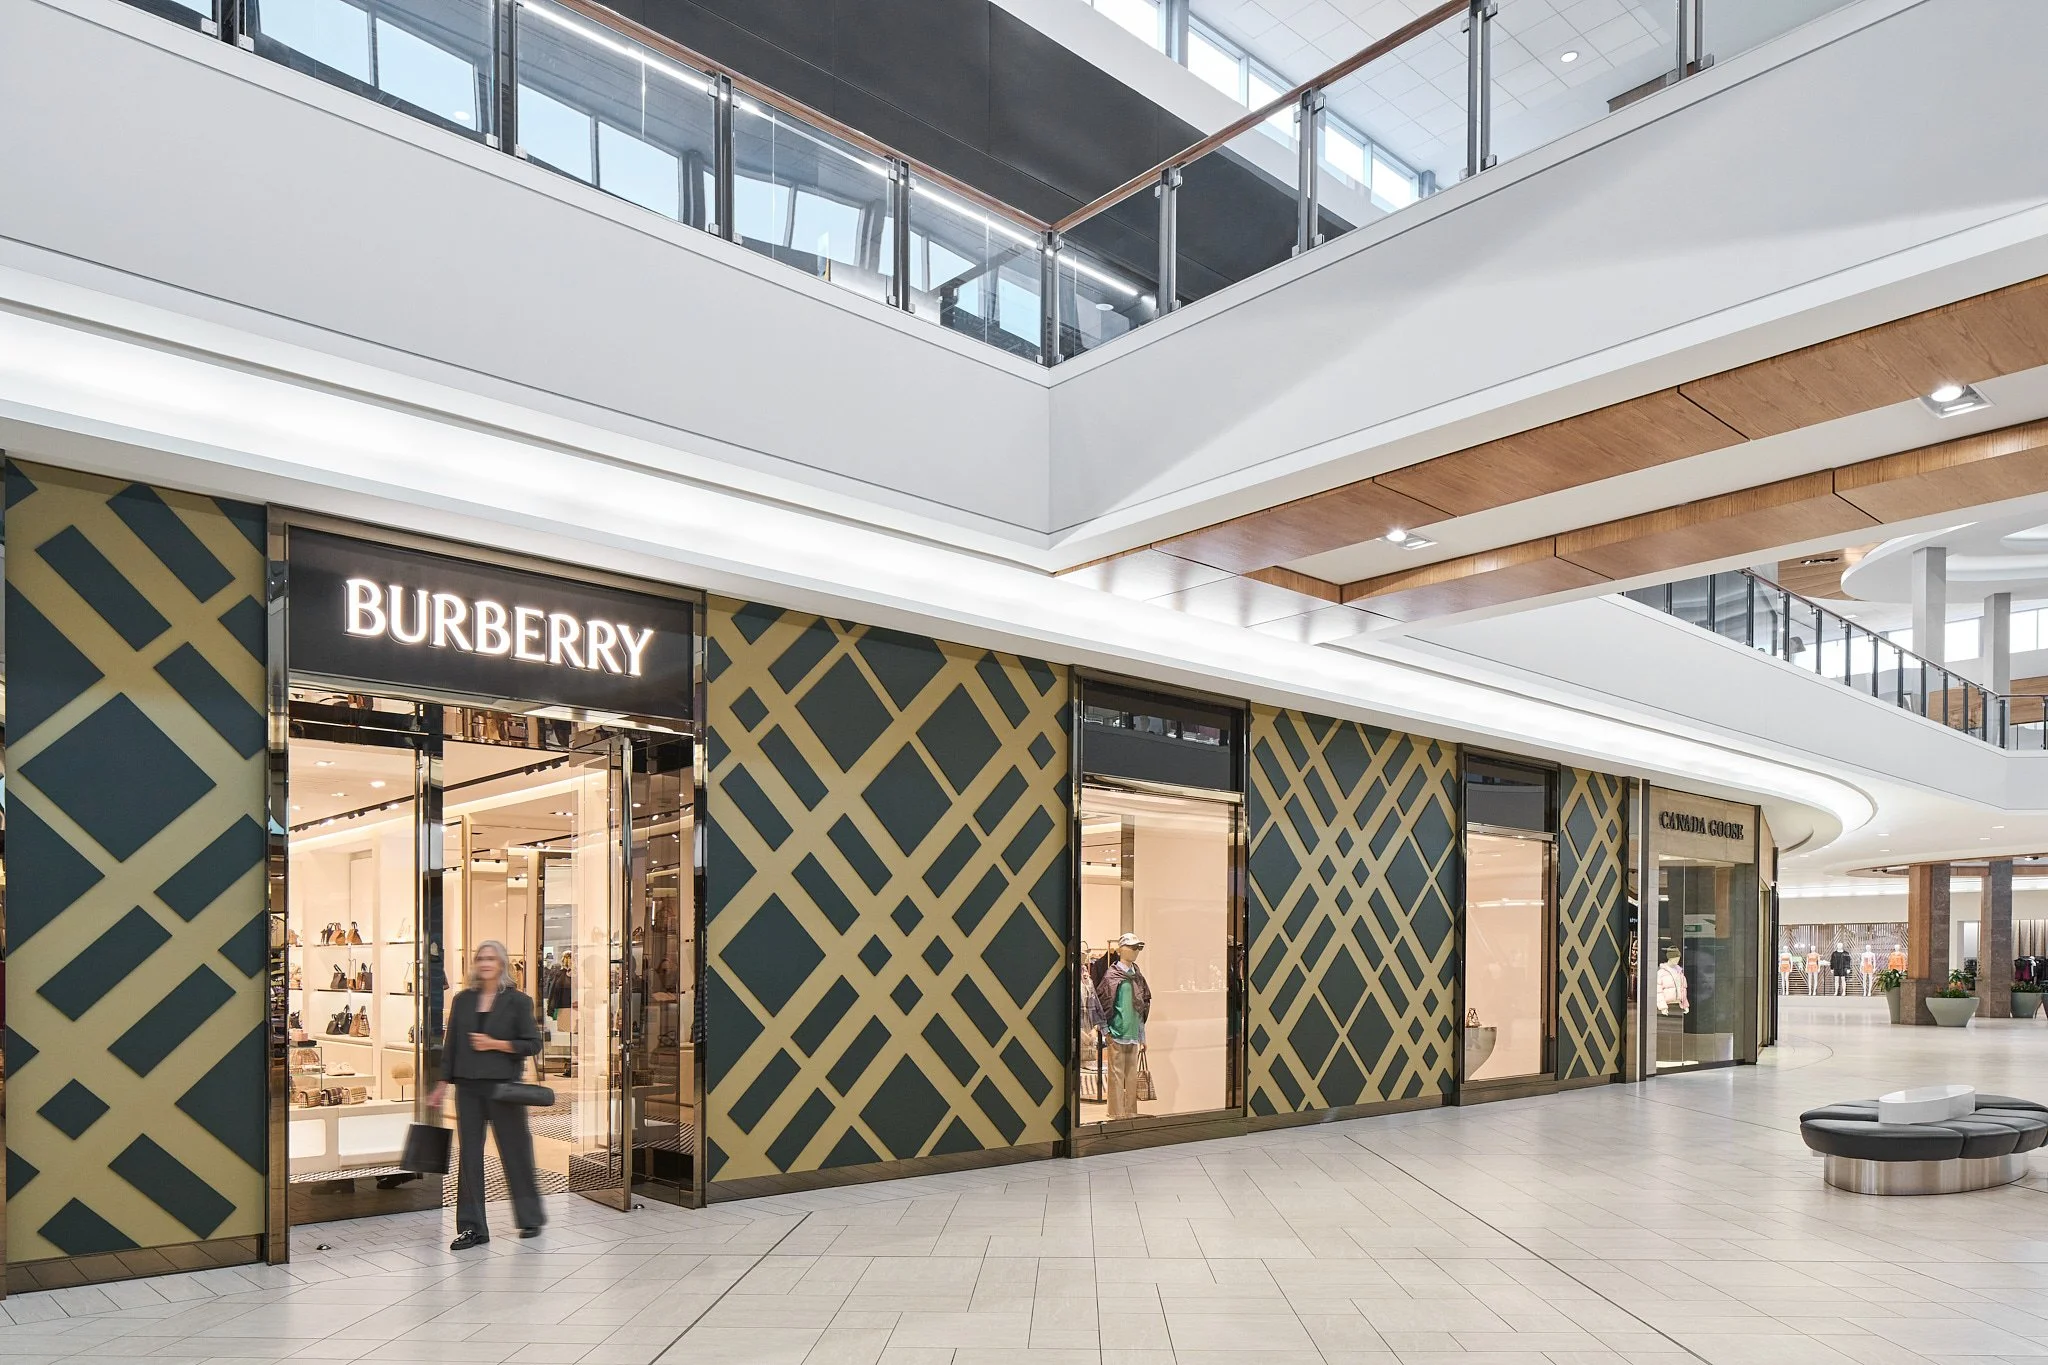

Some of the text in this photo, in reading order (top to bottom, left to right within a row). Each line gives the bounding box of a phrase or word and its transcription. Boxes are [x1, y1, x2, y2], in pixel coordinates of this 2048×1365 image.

[344, 578, 654, 677] BURBERRY
[1659, 811, 1744, 841] CANADA GOOSE
